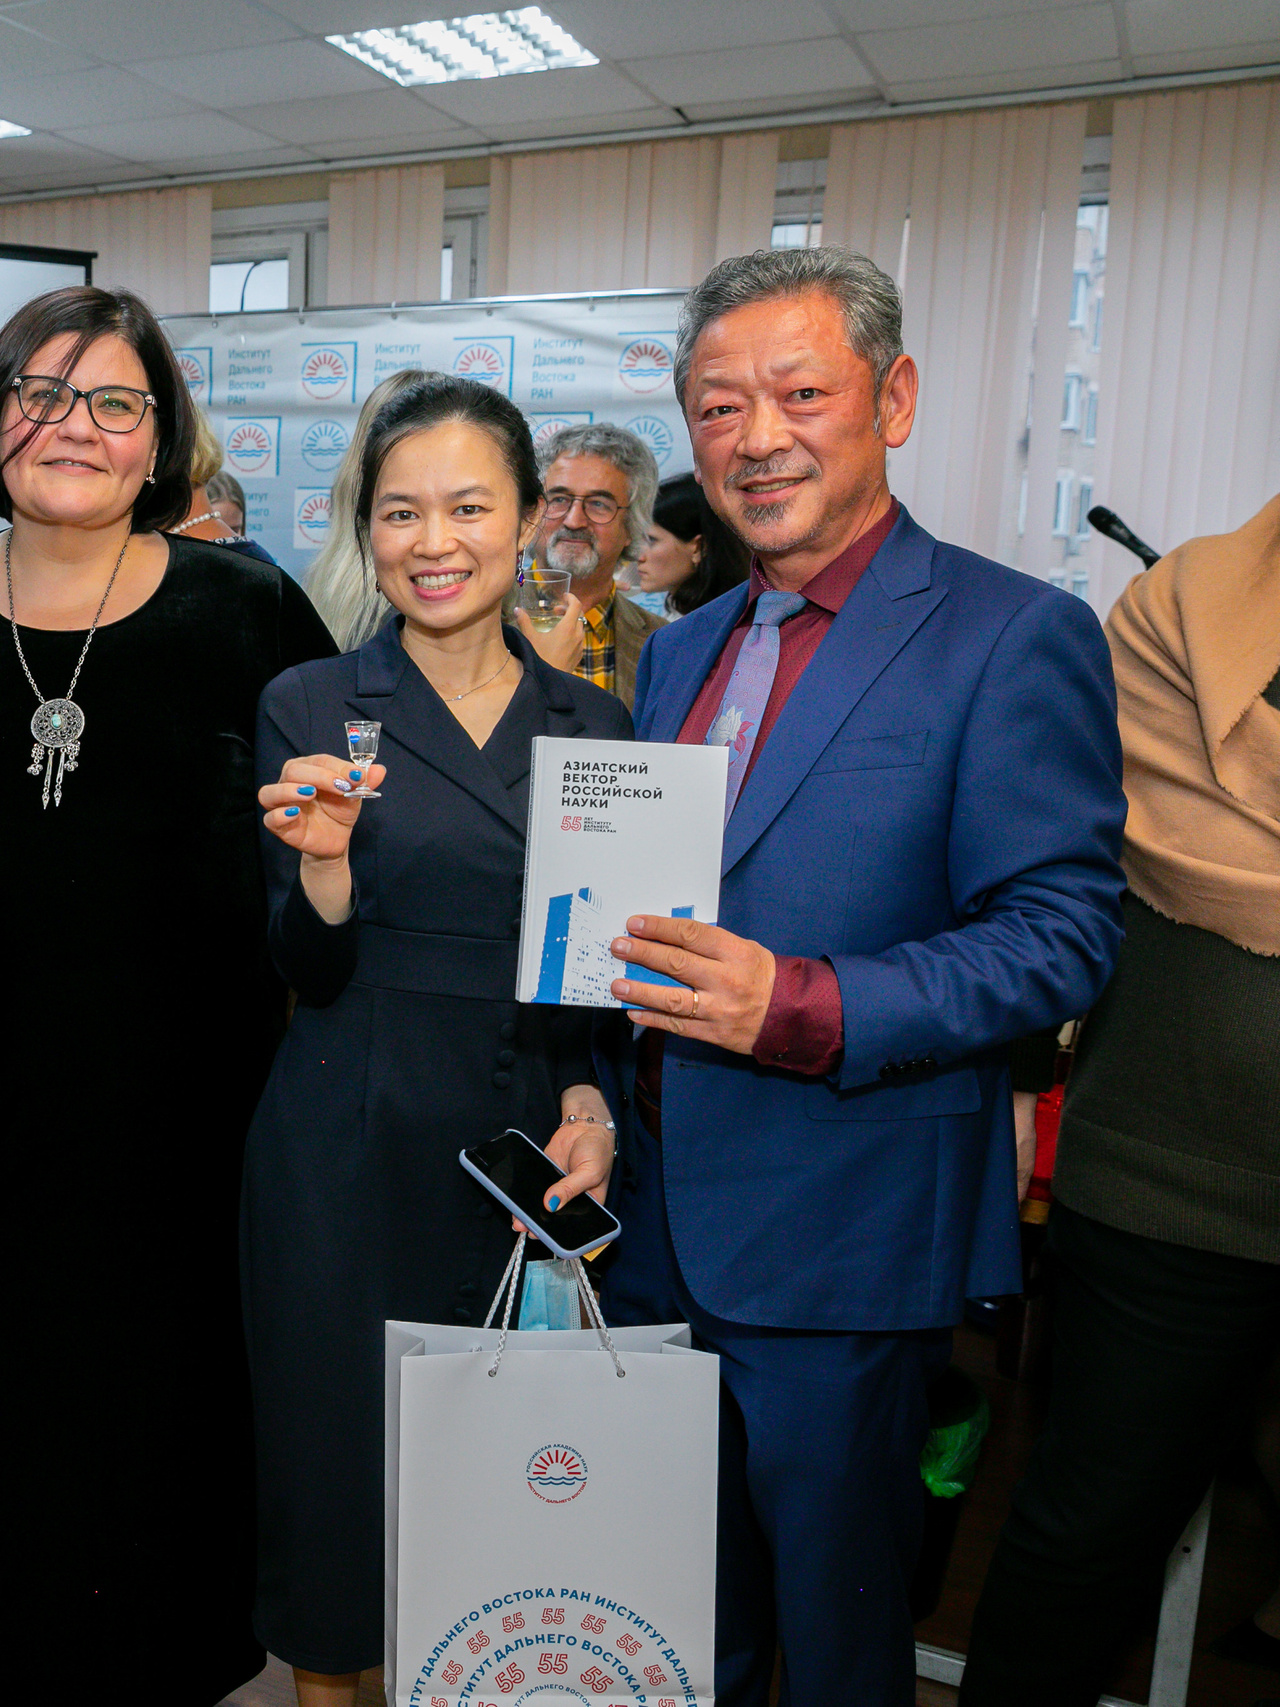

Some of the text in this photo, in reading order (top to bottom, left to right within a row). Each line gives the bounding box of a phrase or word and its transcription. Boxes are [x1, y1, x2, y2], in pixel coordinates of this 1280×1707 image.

[375, 344, 420, 354] Институт
[533, 338, 583, 349] Институт
[228, 349, 271, 359] Институт
[532, 354, 585, 367] Дальнего
[228, 364, 273, 375] Дальнего
[532, 371, 576, 382] Востока
[228, 380, 266, 390] Востока
[531, 388, 553, 399] РАН
[227, 395, 246, 405] РАН
[563, 761, 649, 775] АЗИАТСКИЙ
[563, 773, 618, 785] ВЕКТОР
[562, 785, 663, 800] РОССИЙСКОЙ
[561, 797, 609, 809] НАУКИ
[560, 815, 582, 831] 55
[526, 1444, 552, 1473] РОССИЙСКАЯ
[553, 1443, 582, 1458] АКАДЕМИЯ
[421, 1611, 480, 1678] ДАЛЬНЕГО
[482, 1588, 555, 1614] ВОСТОКА
[560, 1588, 591, 1603] РАН
[595, 1595, 668, 1647] ИНСТИТУТ
[661, 1648, 698, 1707] ДАЛЬНЕ
[441, 1660, 464, 1685] 55
[466, 1630, 490, 1654] 55
[502, 1612, 526, 1633] 55
[541, 1608, 566, 1625] 55
[580, 1614, 607, 1635] 55
[616, 1633, 643, 1656] 55
[643, 1664, 668, 1687] 55
[458, 1633, 641, 1707] СТИТУТ ДАЛЬНЕГО ВОСТОКА
[494, 1653, 615, 1694] 55 55 55
[525, 1683, 564, 1698] ДАЛЬНЕГО
[565, 1686, 592, 1707] ВОСТОК
